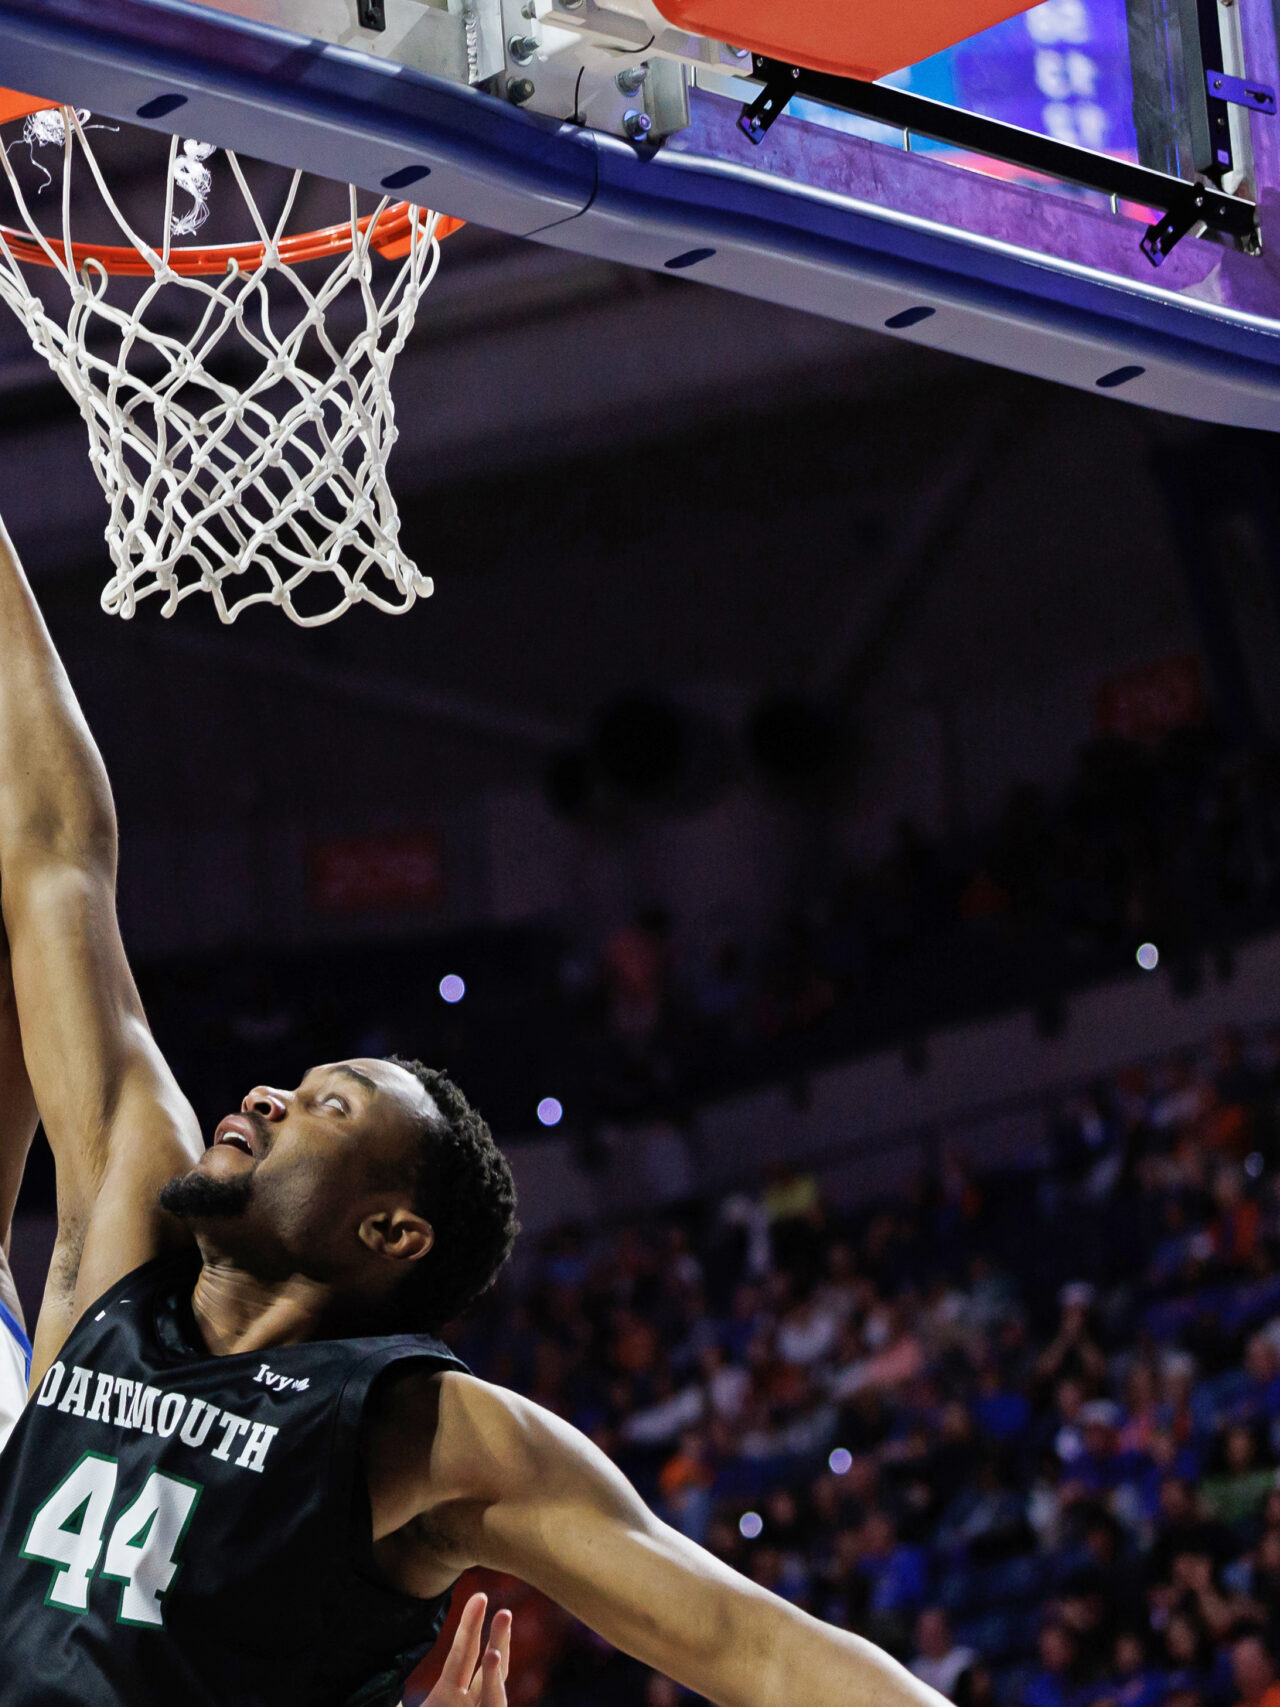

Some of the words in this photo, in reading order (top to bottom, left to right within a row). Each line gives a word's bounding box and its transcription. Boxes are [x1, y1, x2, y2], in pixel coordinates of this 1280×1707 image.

[37, 1361, 279, 1473] DARTMOUTH
[252, 1364, 293, 1392] Ivy
[19, 1450, 204, 1630] 44
